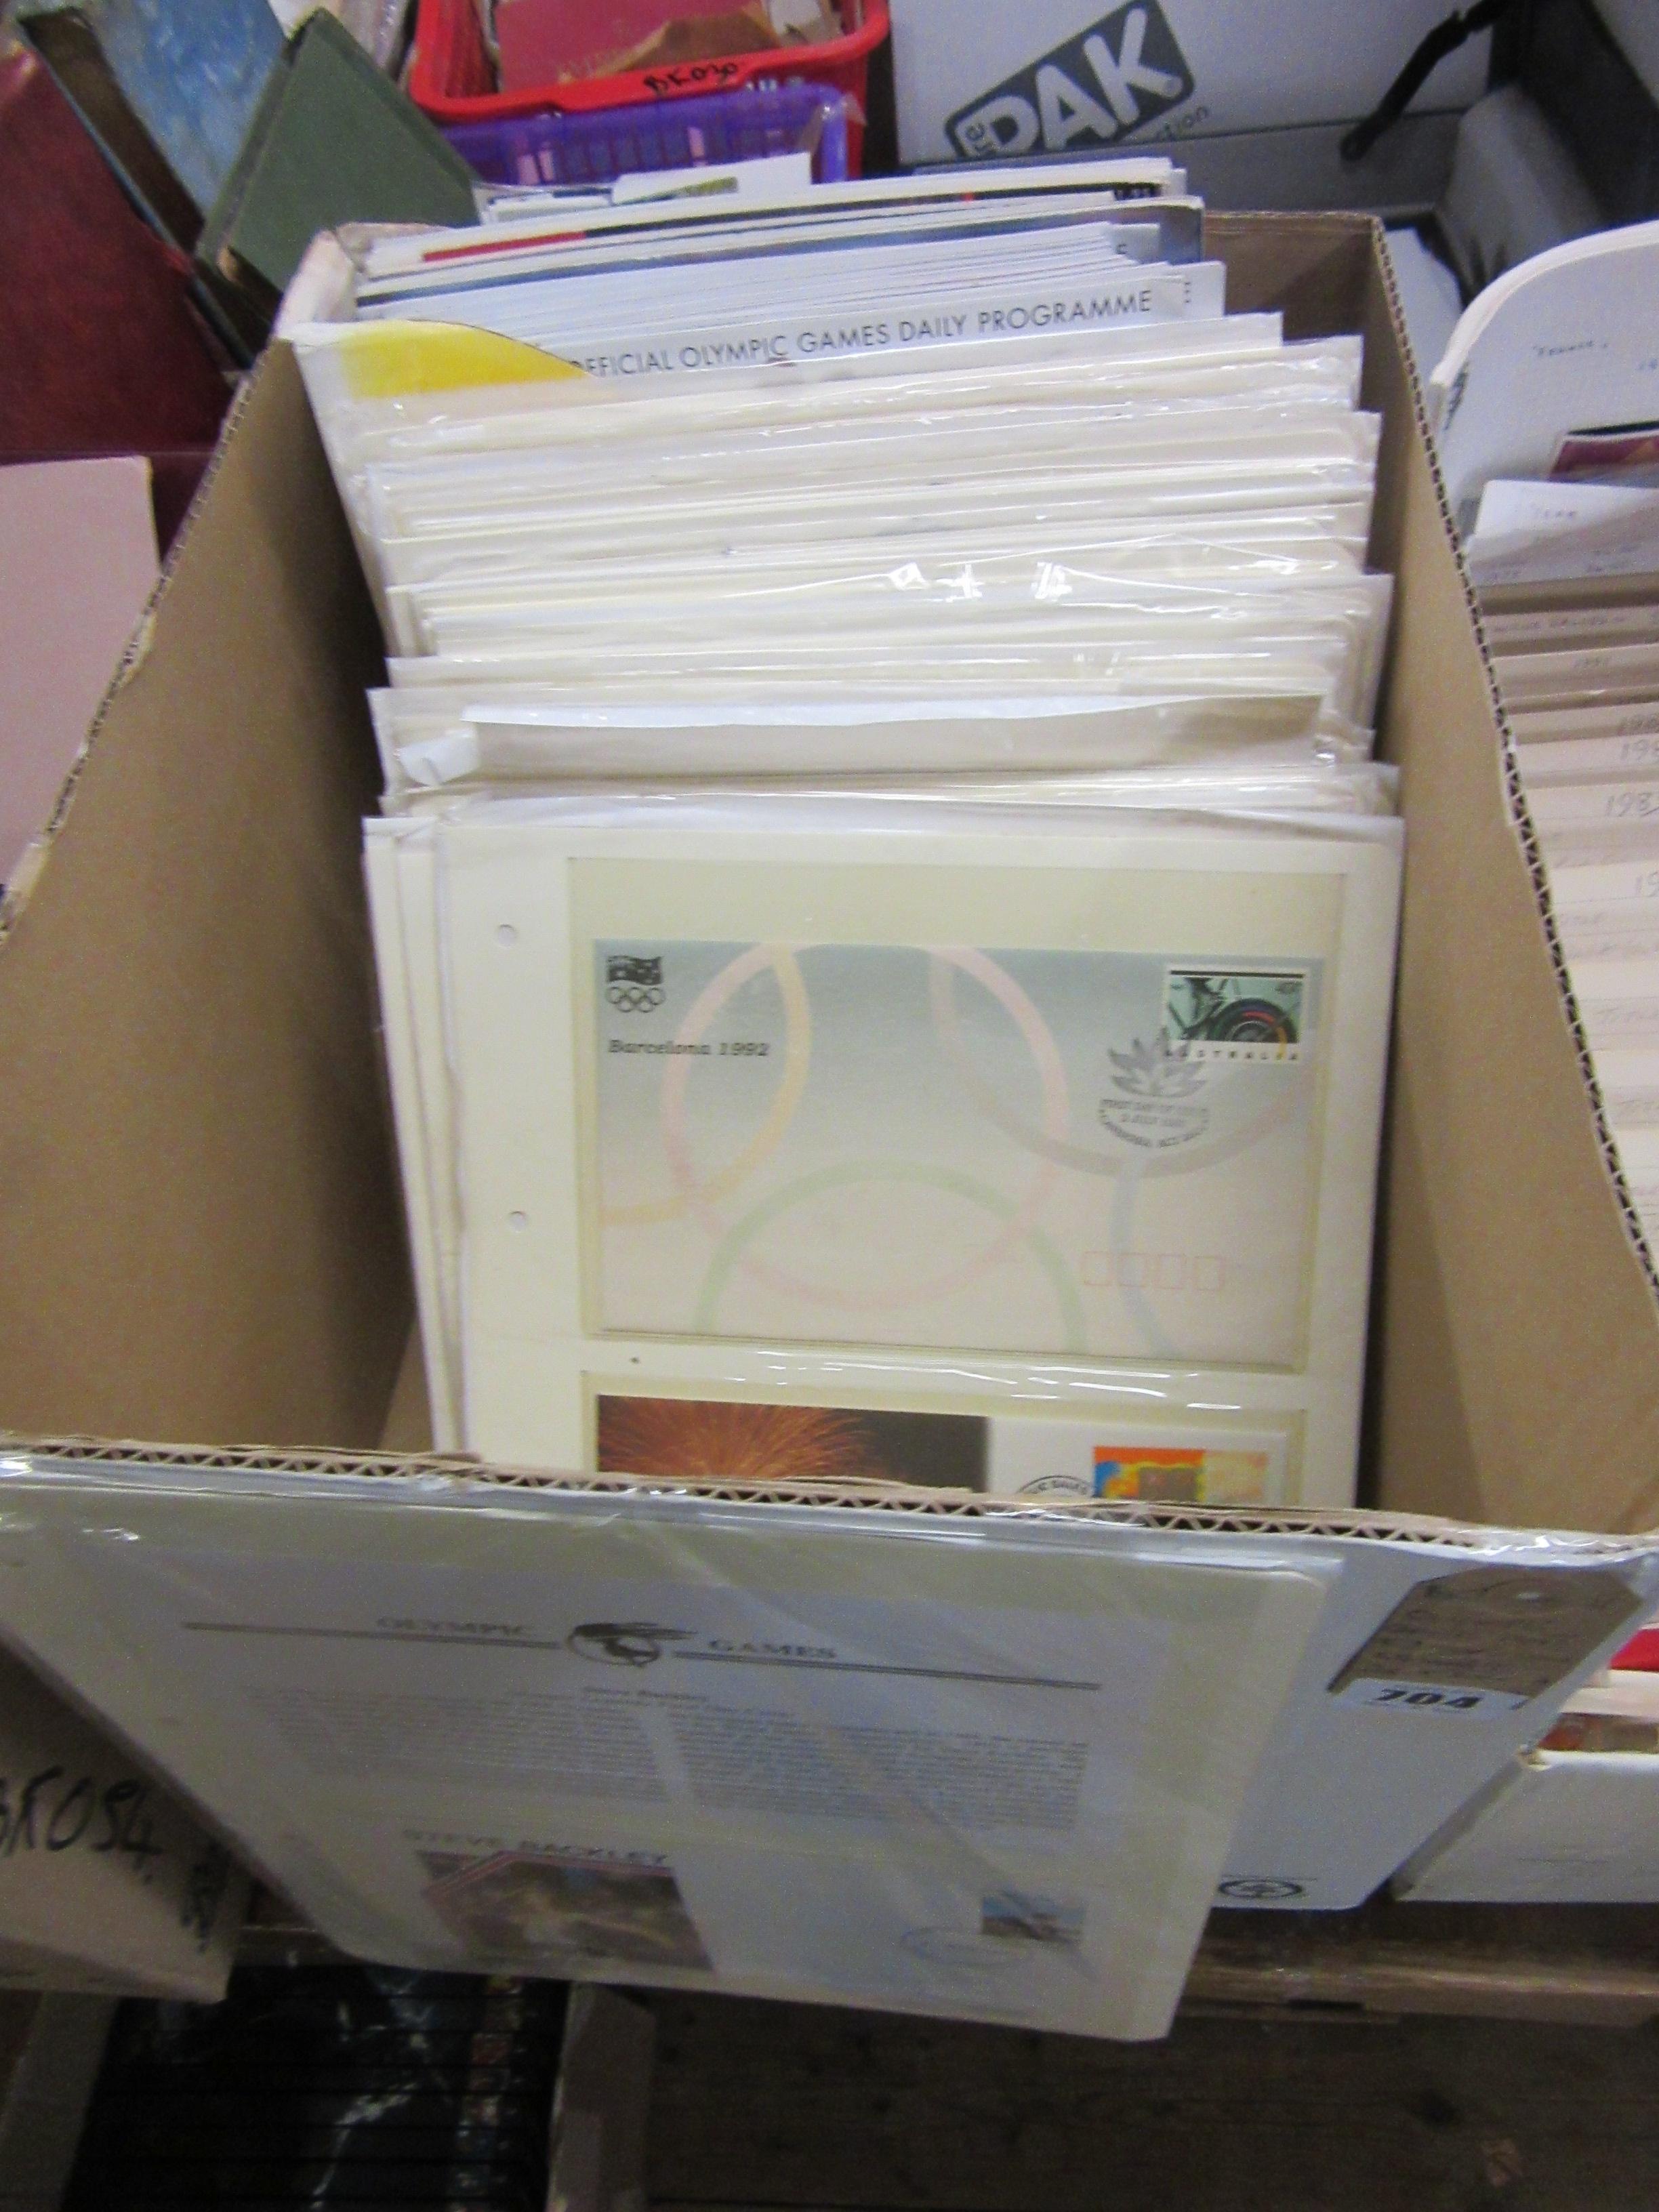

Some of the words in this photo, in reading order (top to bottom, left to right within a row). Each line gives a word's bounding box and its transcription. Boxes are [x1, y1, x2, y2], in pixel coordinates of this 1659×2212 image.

[679, 334, 790, 368] OLYMPIC
[796, 323, 891, 353] GAMES
[898, 314, 967, 342] DAILY
[978, 289, 1152, 334] PROGRAMME
[609, 1039, 712, 1057] Barcelona
[718, 1042, 771, 1057] 1992
[708, 1638, 838, 1660] GAMES
